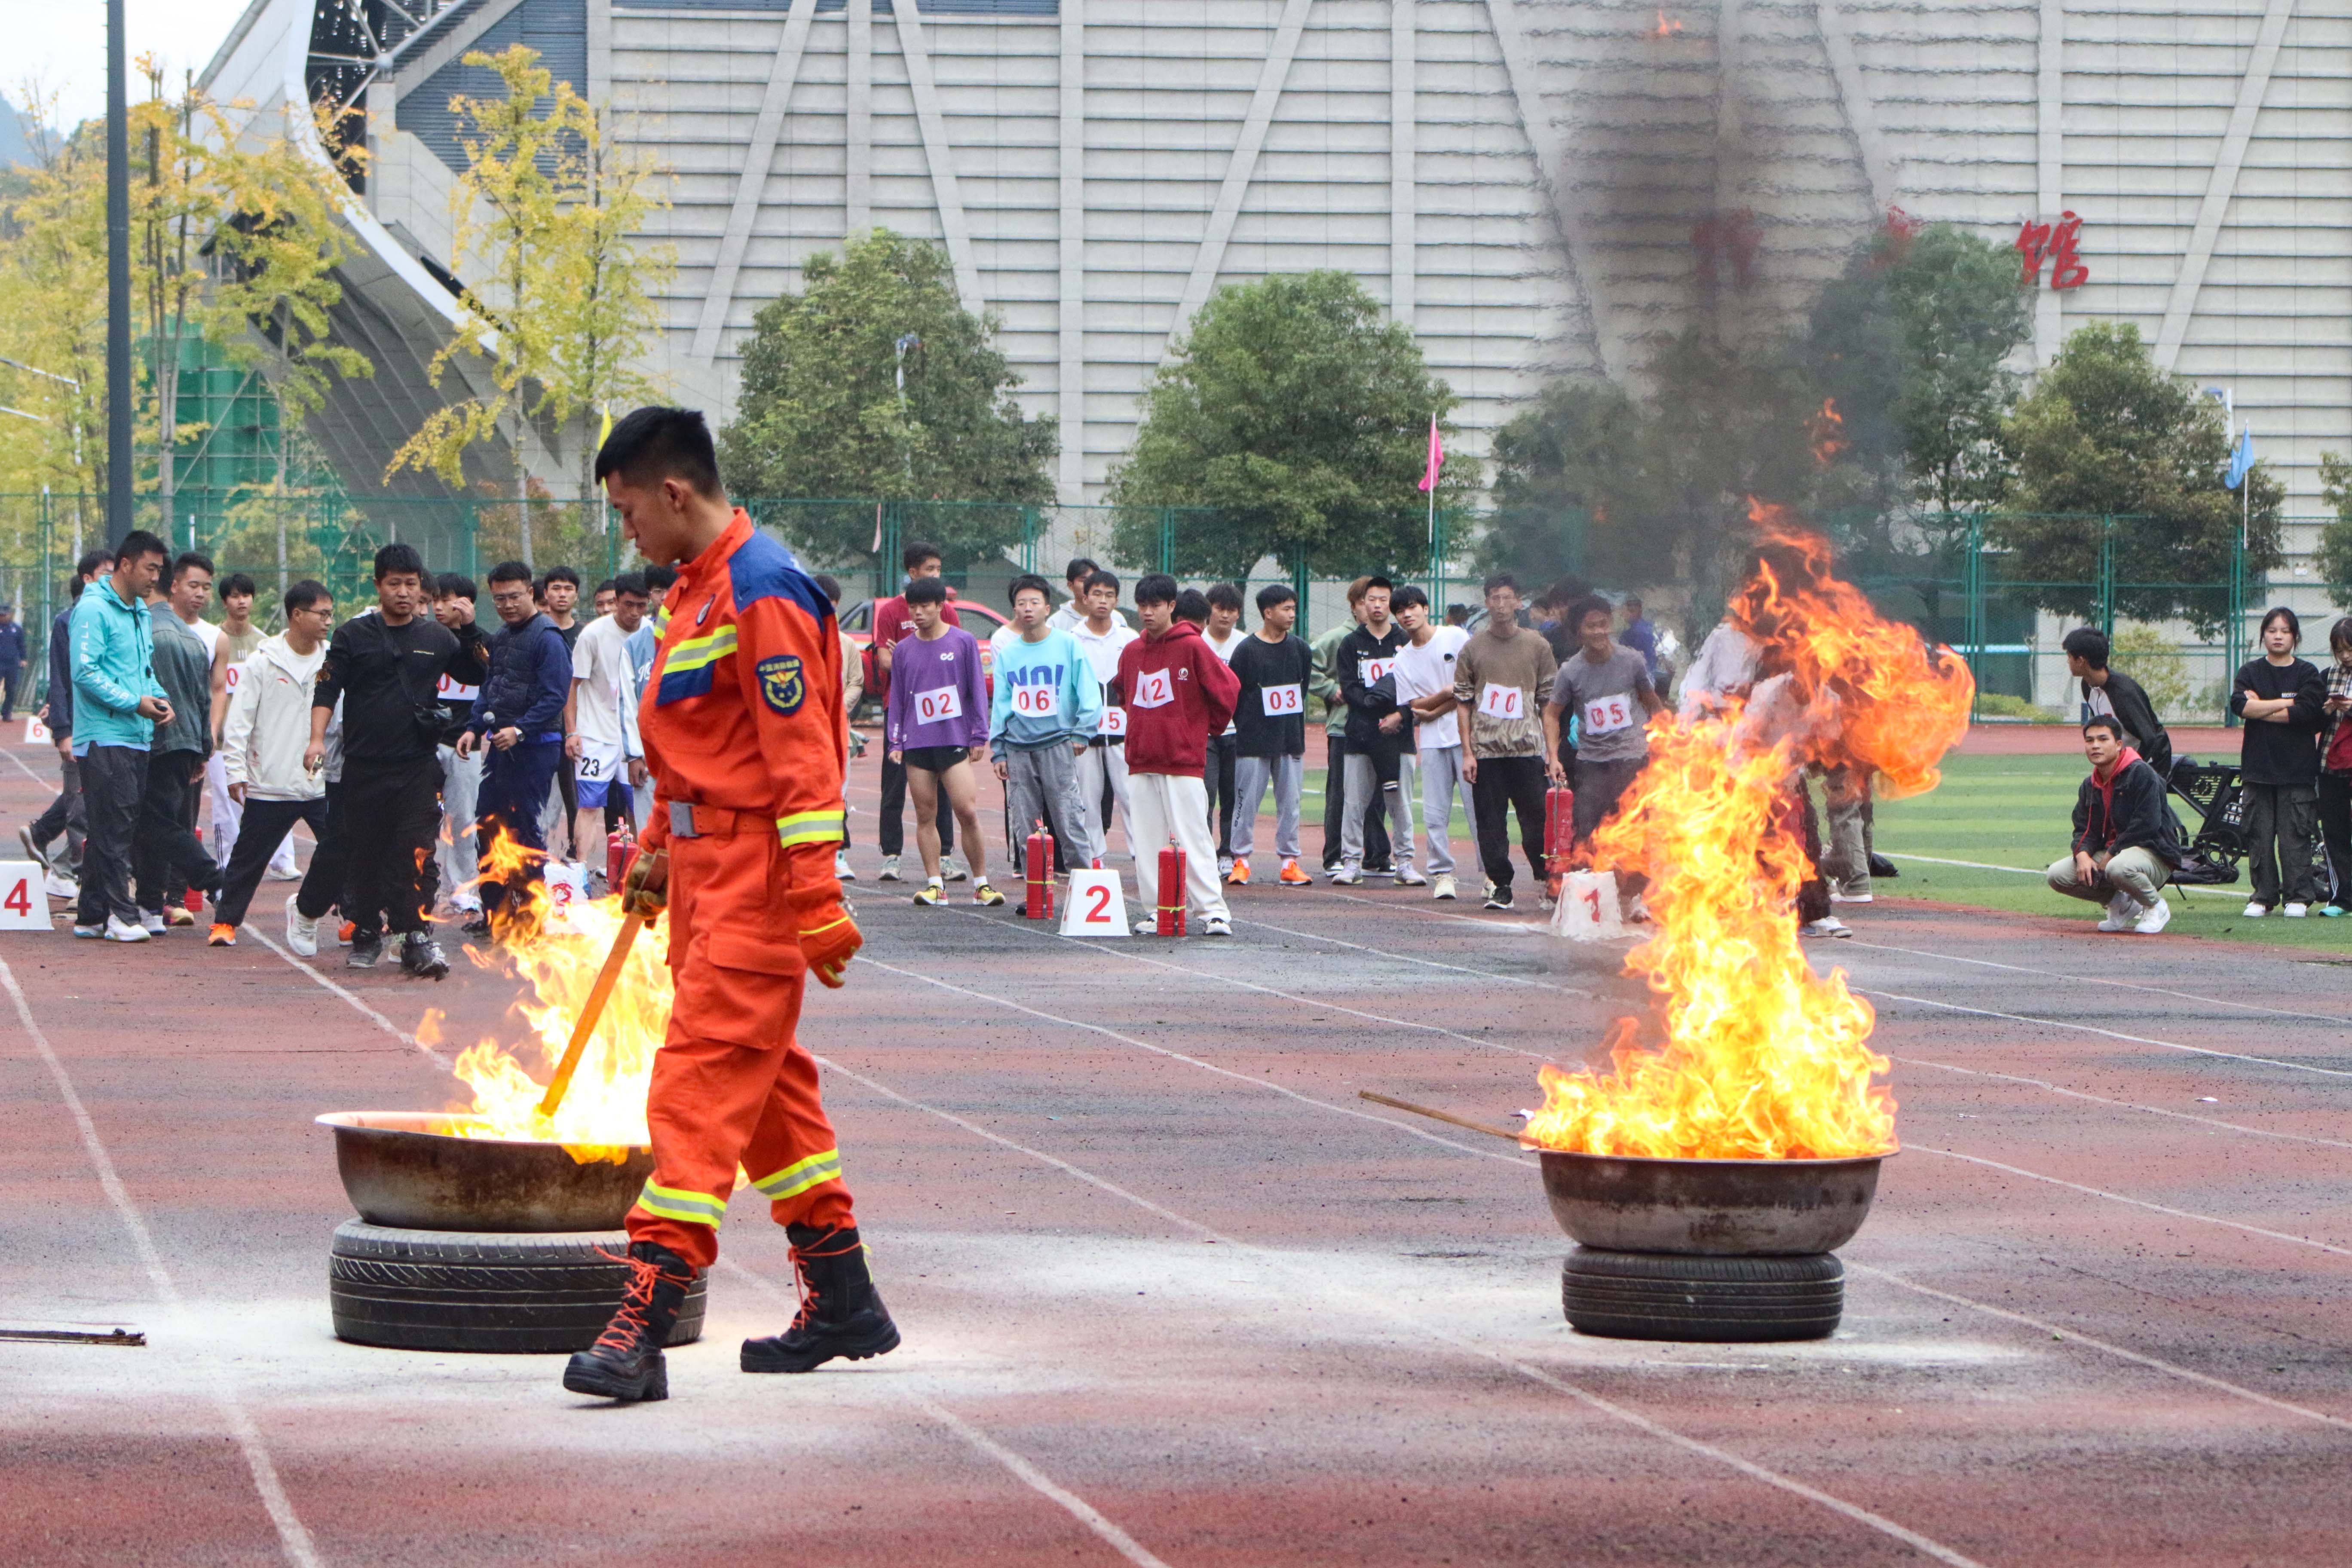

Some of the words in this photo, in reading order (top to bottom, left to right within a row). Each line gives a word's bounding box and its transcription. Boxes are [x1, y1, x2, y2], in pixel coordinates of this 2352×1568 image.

[1371, 663, 1394, 682] 0
[922, 693, 953, 718] 02
[1018, 690, 1050, 711] 06
[1270, 690, 1296, 710] 03
[1591, 703, 1624, 728] 05
[33, 723, 44, 737] 6
[581, 757, 600, 777] 23
[4, 879, 32, 916] 4
[1085, 885, 1111, 922] 2
[1584, 888, 1600, 922] 1
